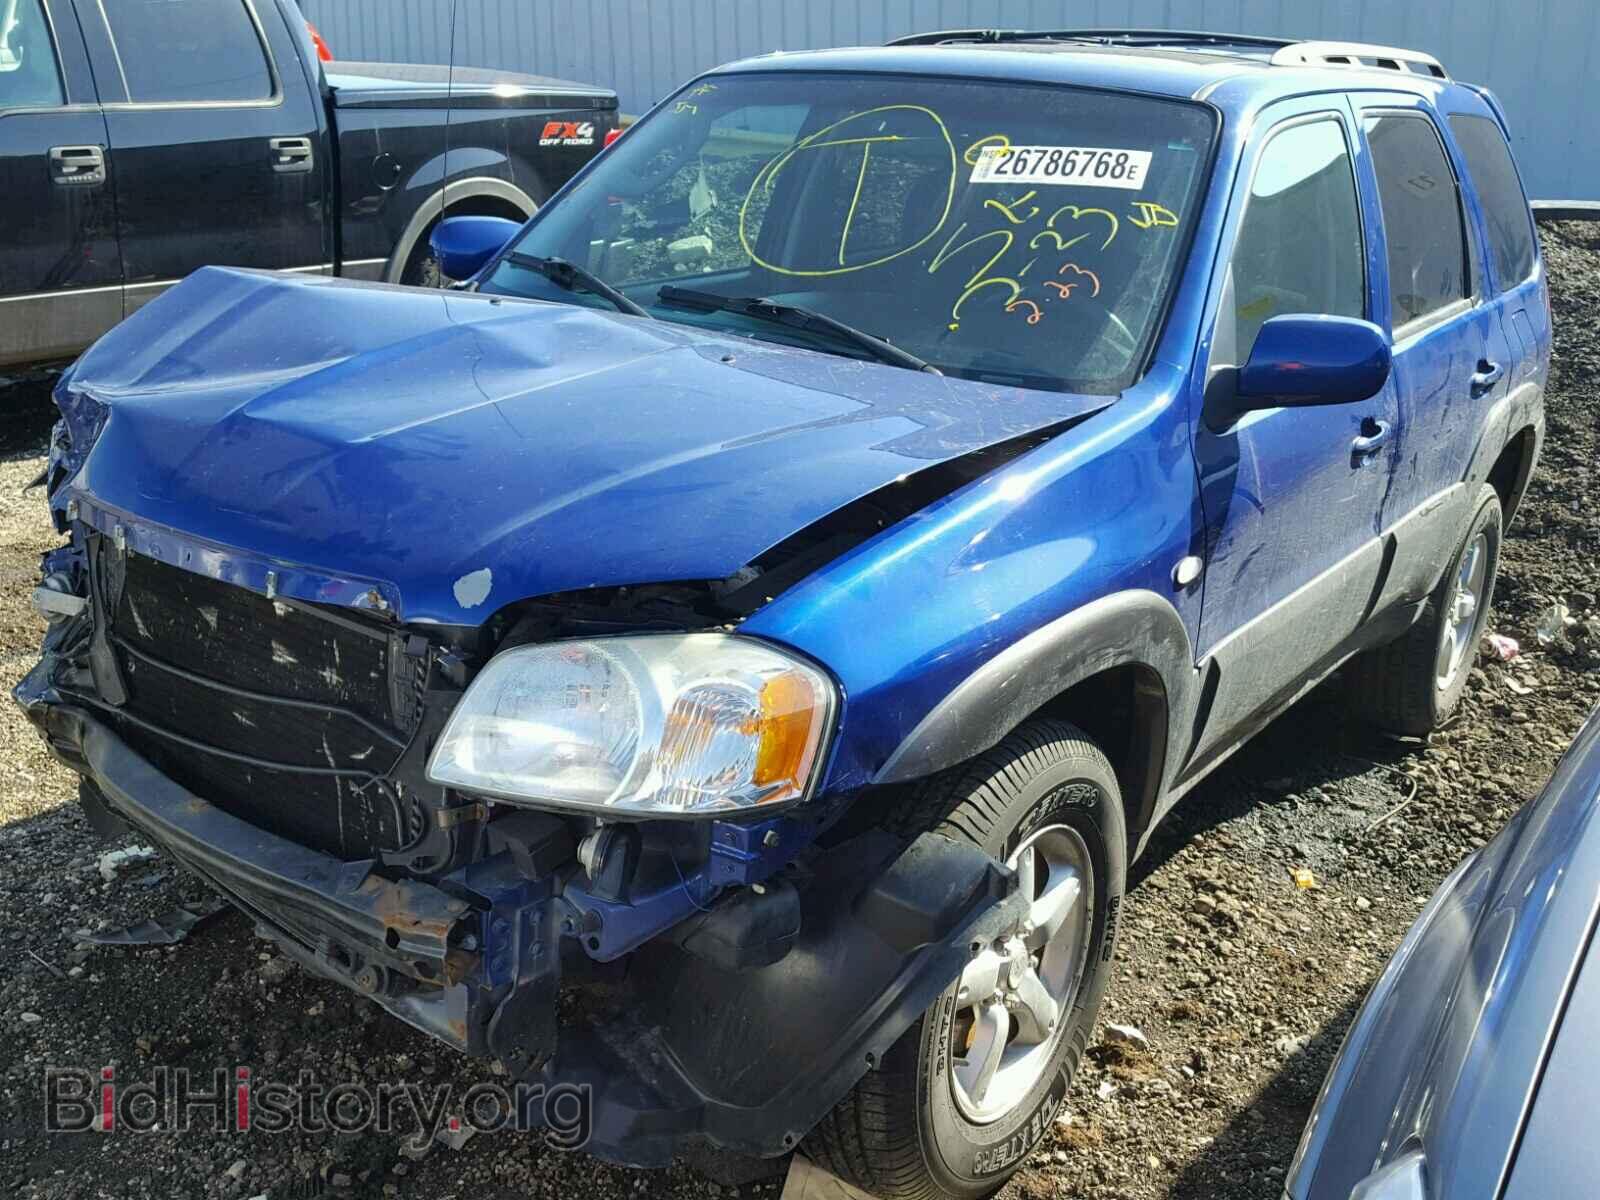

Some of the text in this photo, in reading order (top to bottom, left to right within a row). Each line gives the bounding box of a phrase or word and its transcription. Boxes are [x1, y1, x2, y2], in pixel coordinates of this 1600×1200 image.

[542, 122, 594, 138] FX4
[539, 138, 594, 146] OFF ROAD
